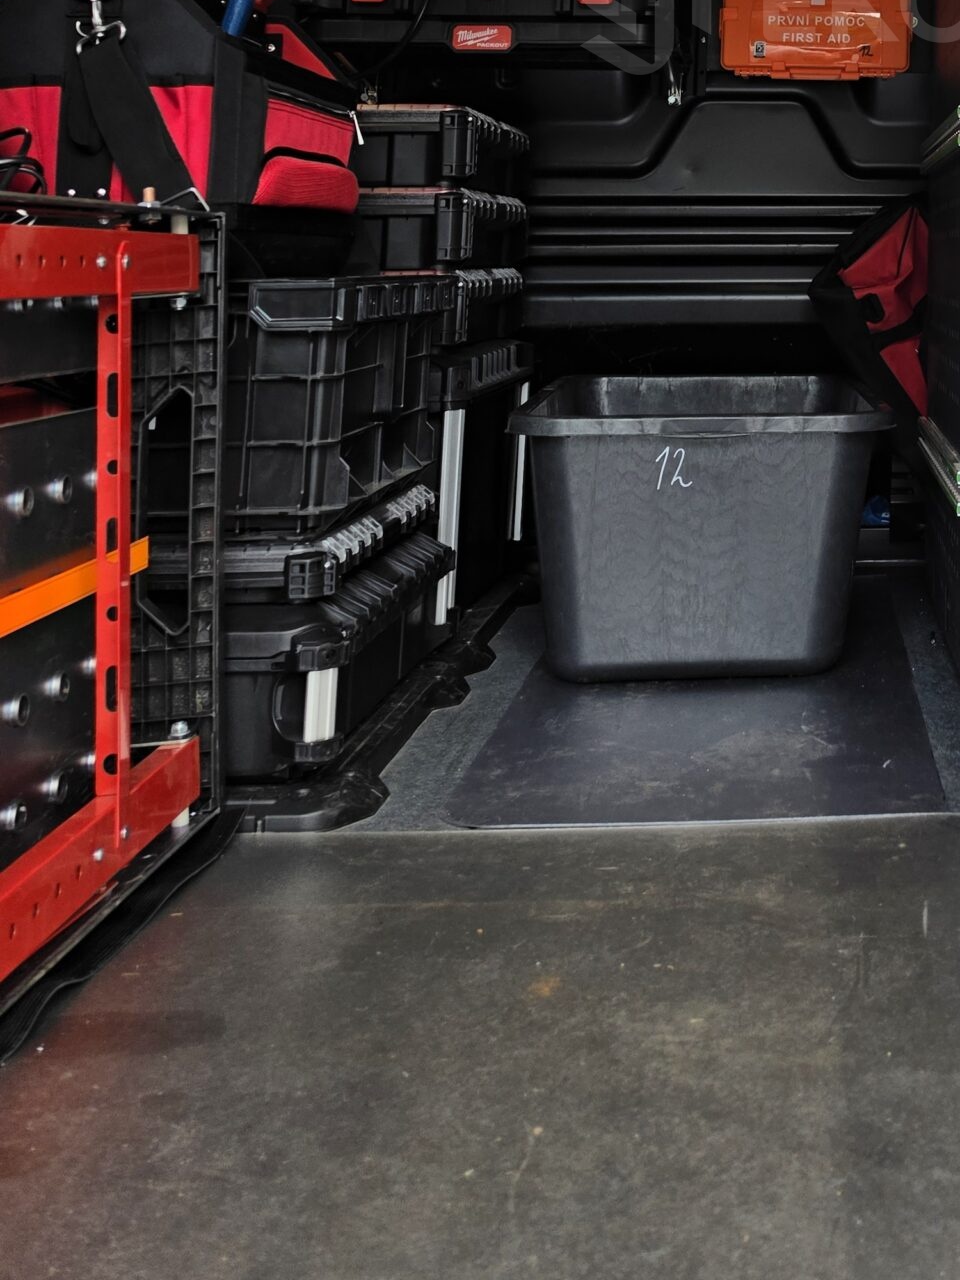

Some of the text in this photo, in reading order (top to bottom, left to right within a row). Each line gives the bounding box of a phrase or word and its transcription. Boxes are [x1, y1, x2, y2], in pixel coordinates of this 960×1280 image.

[767, 14, 865, 27] PRVNÍ POMOC
[456, 27, 499, 43] Milwaukee
[782, 32, 851, 44] FIRST AID
[655, 446, 693, 491] 12
